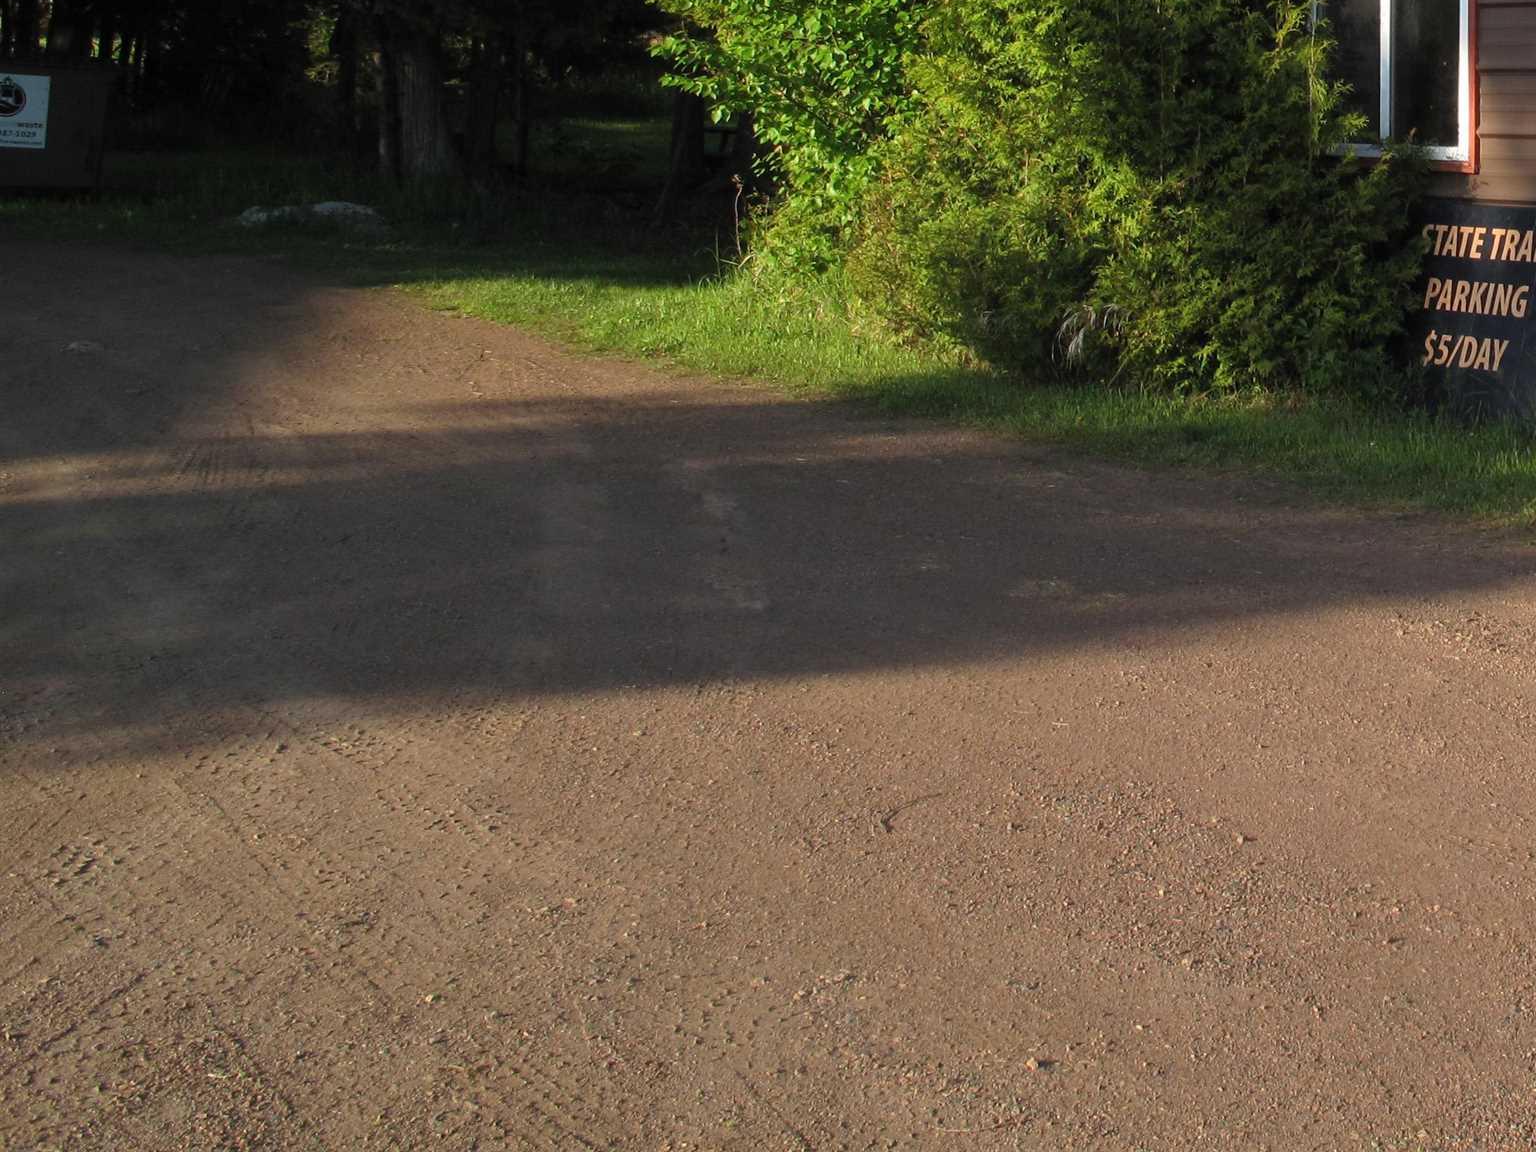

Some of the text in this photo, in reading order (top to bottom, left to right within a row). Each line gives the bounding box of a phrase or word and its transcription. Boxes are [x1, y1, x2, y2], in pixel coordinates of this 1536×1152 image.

[1421, 223, 1487, 260] STATE
[1423, 276, 1530, 319] PARKING
[1422, 329, 1510, 372] $5/DAY
